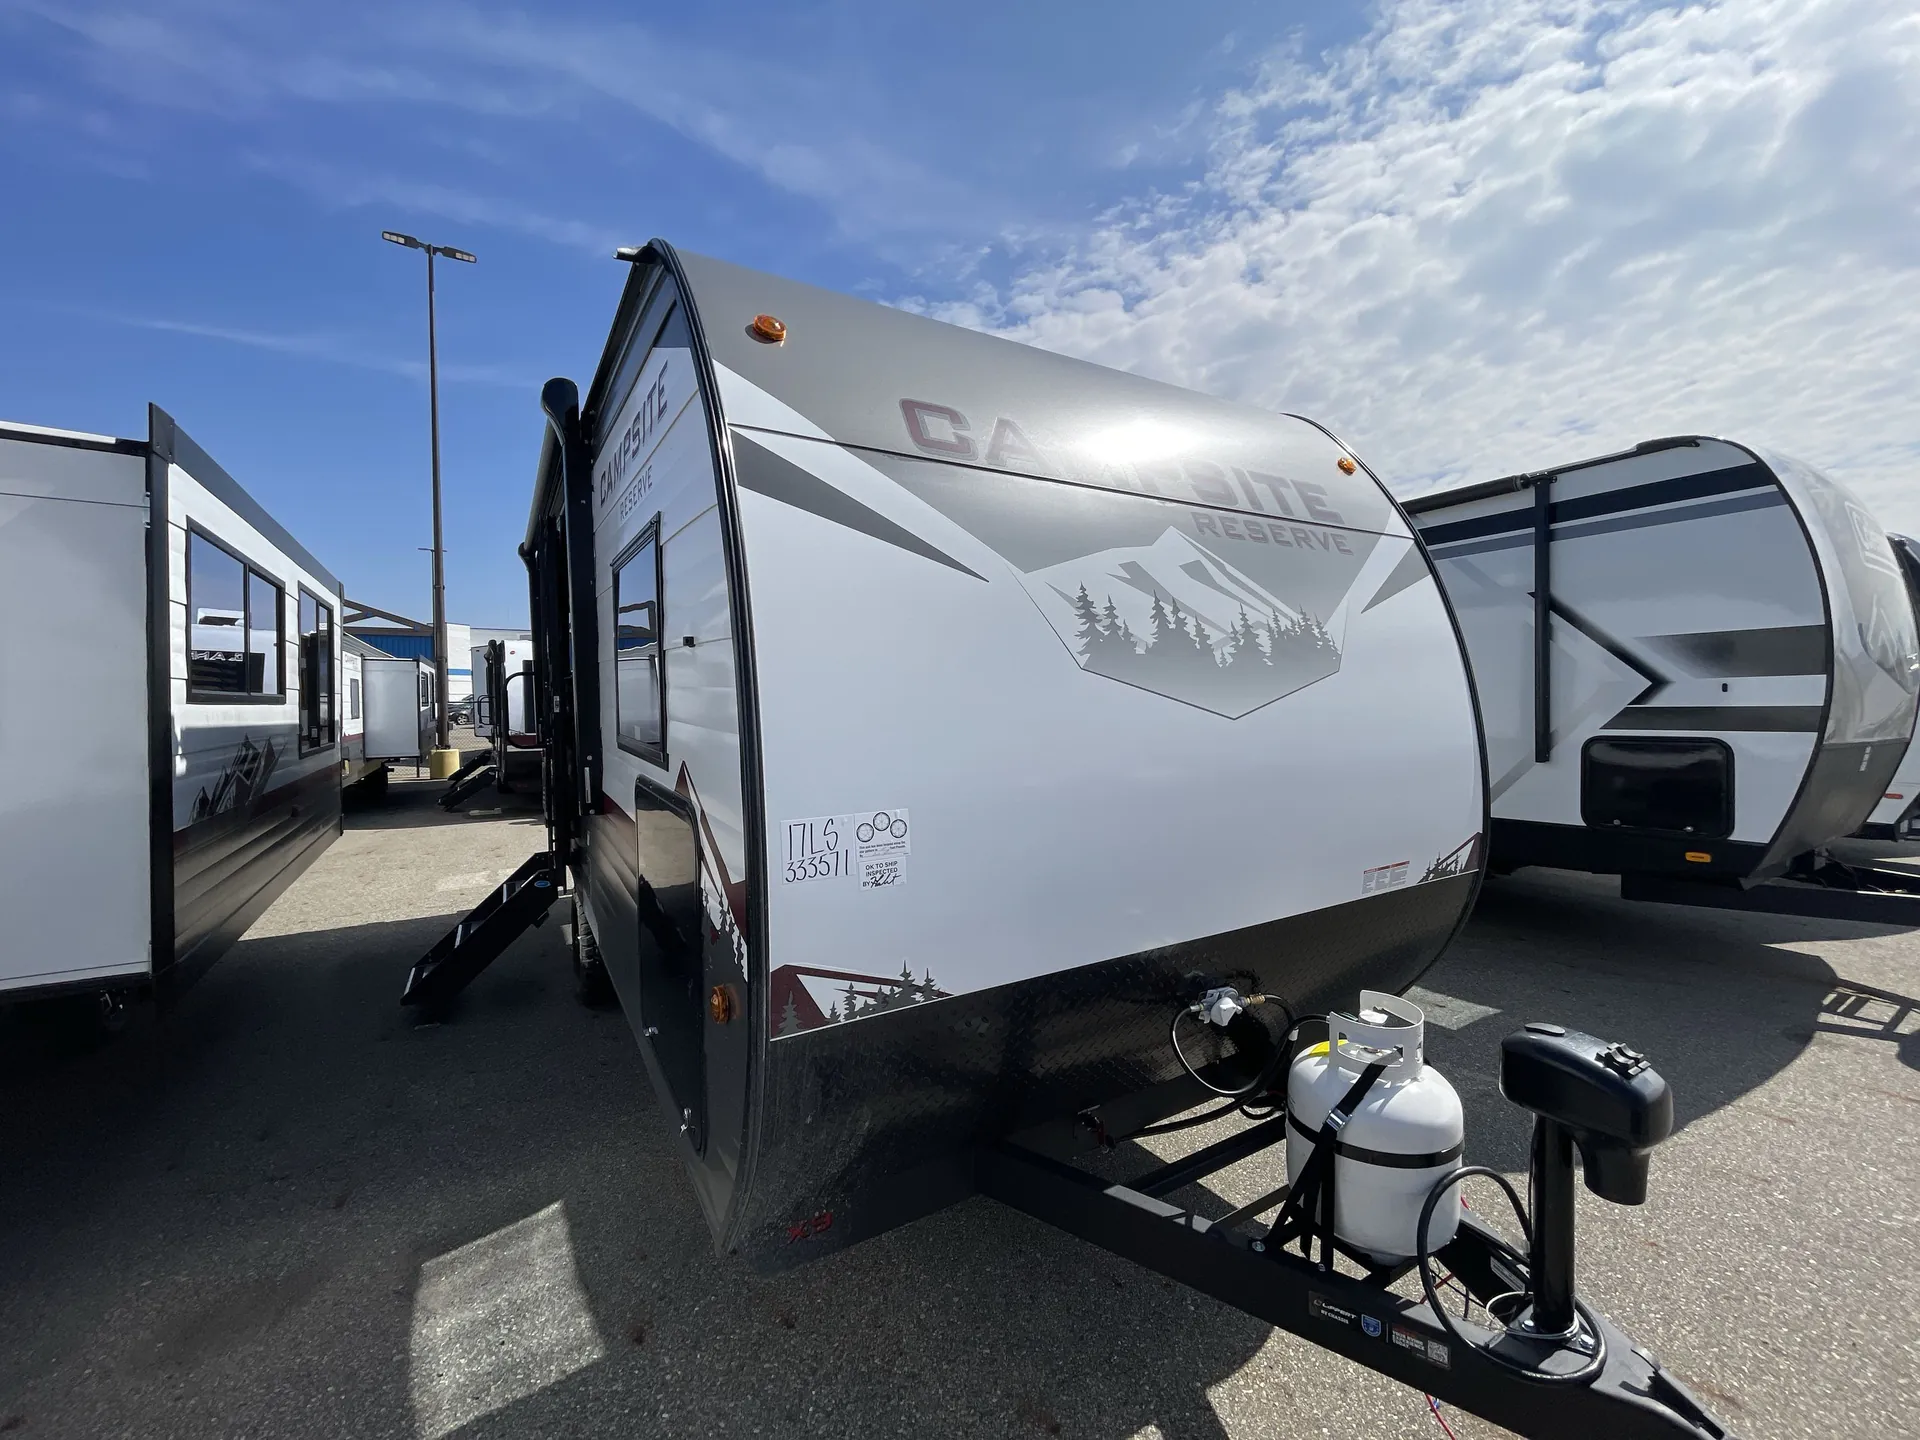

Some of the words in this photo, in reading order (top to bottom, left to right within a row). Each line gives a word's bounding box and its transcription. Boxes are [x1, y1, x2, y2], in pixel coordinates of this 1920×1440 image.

[600, 359, 669, 509] CAMPSITE
[899, 398, 1345, 523] CASITE
[620, 465, 653, 521] RESERVE
[1191, 511, 1354, 555] RESERVE
[788, 818, 839, 861] 17LS
[785, 849, 849, 883] 333571
[866, 867, 898, 877] INSPECTED
